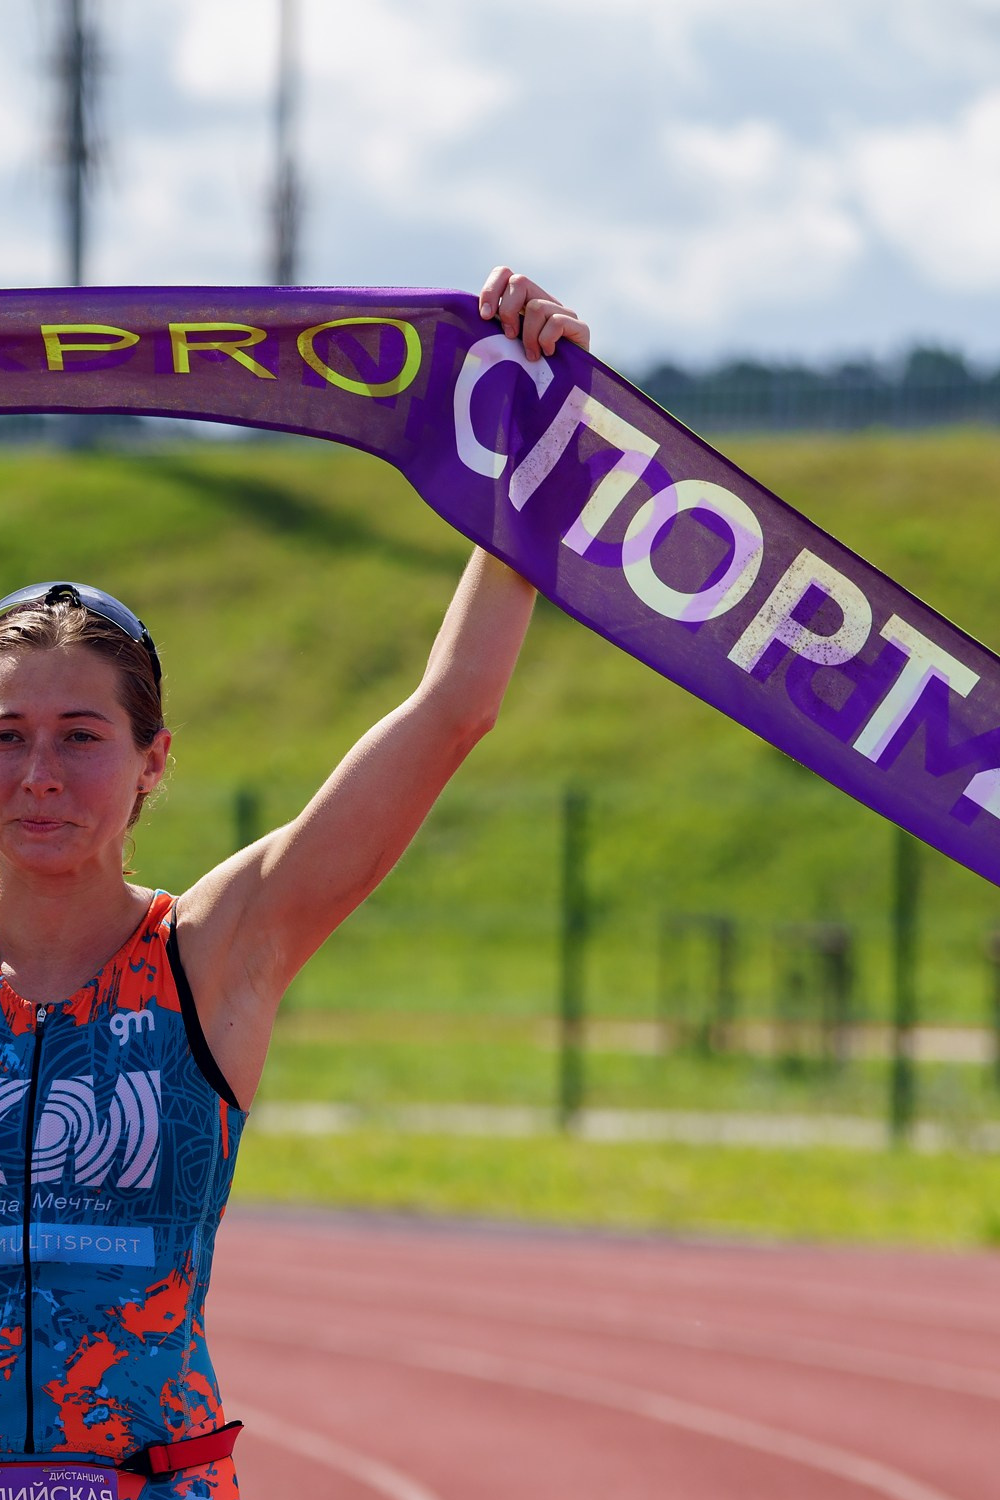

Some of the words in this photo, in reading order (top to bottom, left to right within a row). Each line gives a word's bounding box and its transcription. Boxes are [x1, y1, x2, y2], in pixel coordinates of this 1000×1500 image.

[41, 316, 423, 398] PRO
[453, 333, 1000, 820] СПОРТ
[32, 1192, 112, 1212] Мечты
[49, 1471, 105, 1484] ДИСТАНЦИЯ
